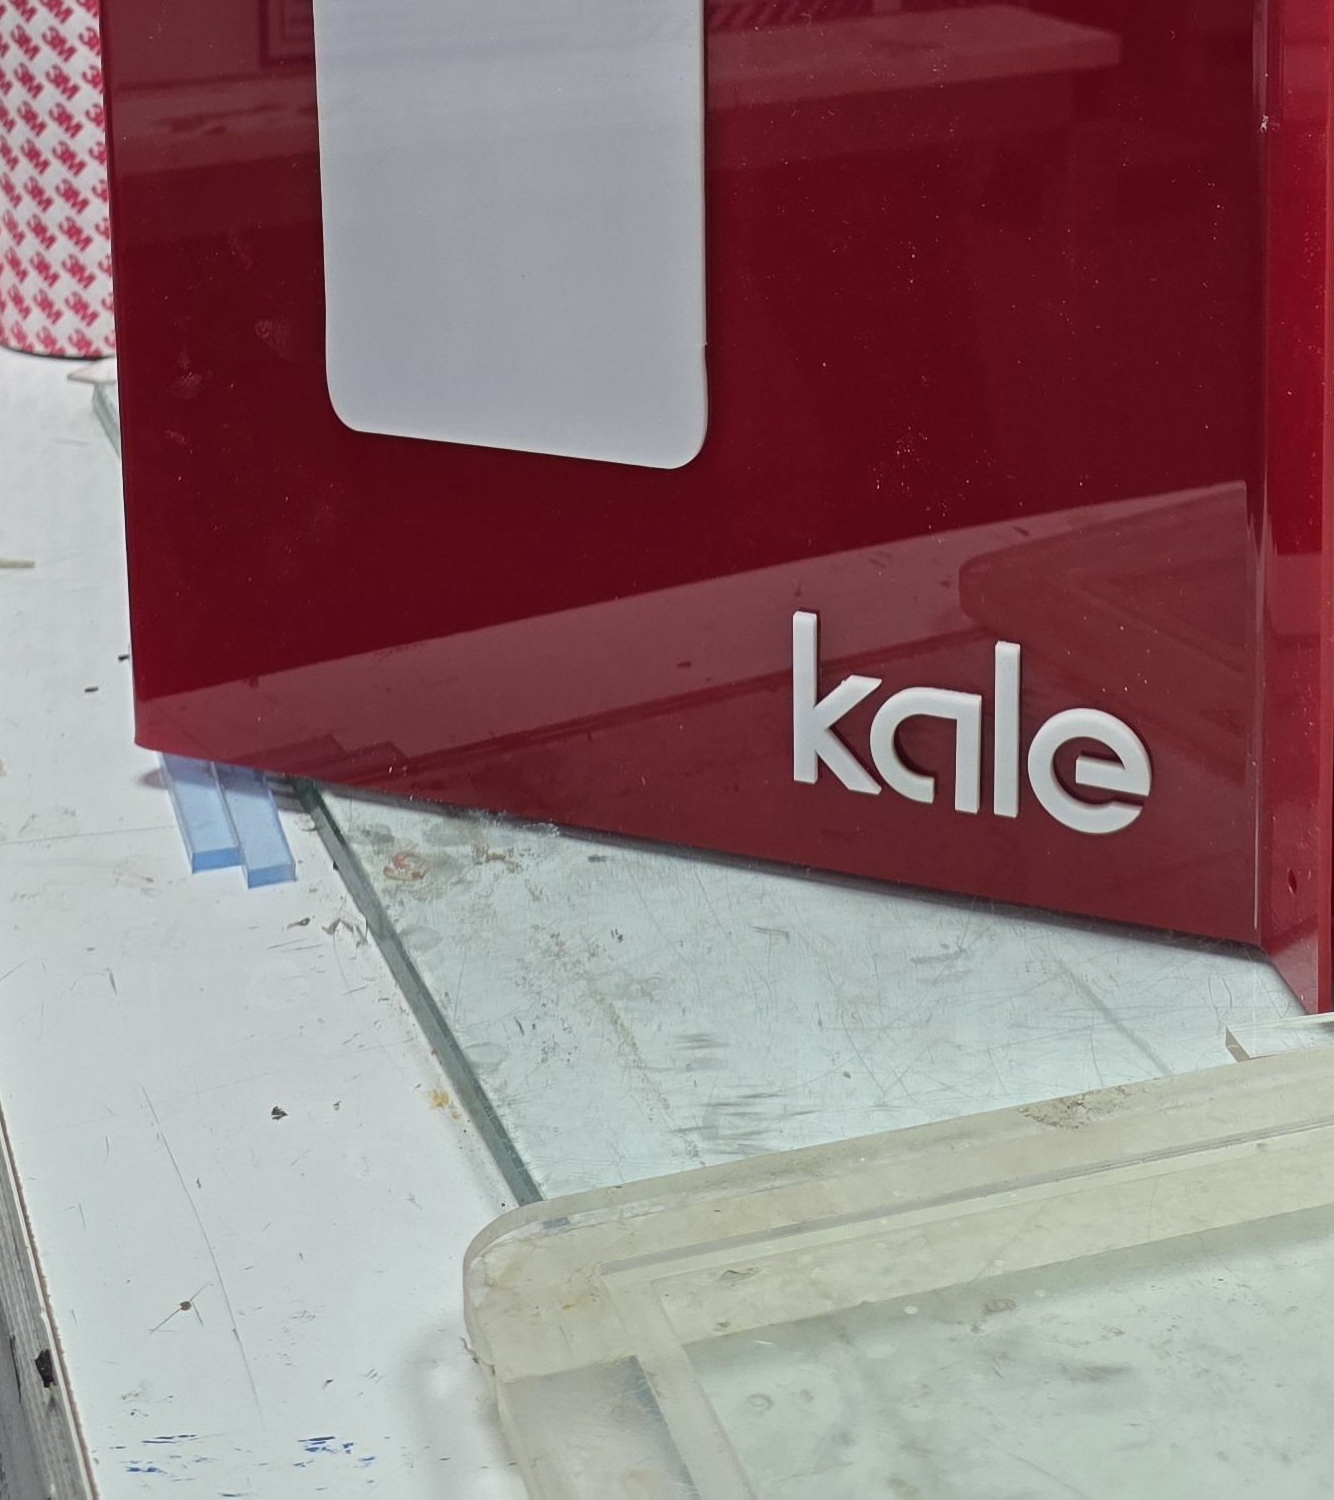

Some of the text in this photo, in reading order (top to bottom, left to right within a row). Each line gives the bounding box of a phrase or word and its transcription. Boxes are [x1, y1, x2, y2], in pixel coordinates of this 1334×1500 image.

[42, 25, 77, 61] 3M
[44, 64, 80, 99] 3M
[46, 102, 84, 138] 3M
[50, 141, 87, 176] 3M
[53, 179, 90, 214] 3M
[56, 216, 93, 251] 3M
[59, 253, 96, 289] 3M
[62, 290, 100, 326] 3M
[792, 609, 1154, 836] kale
